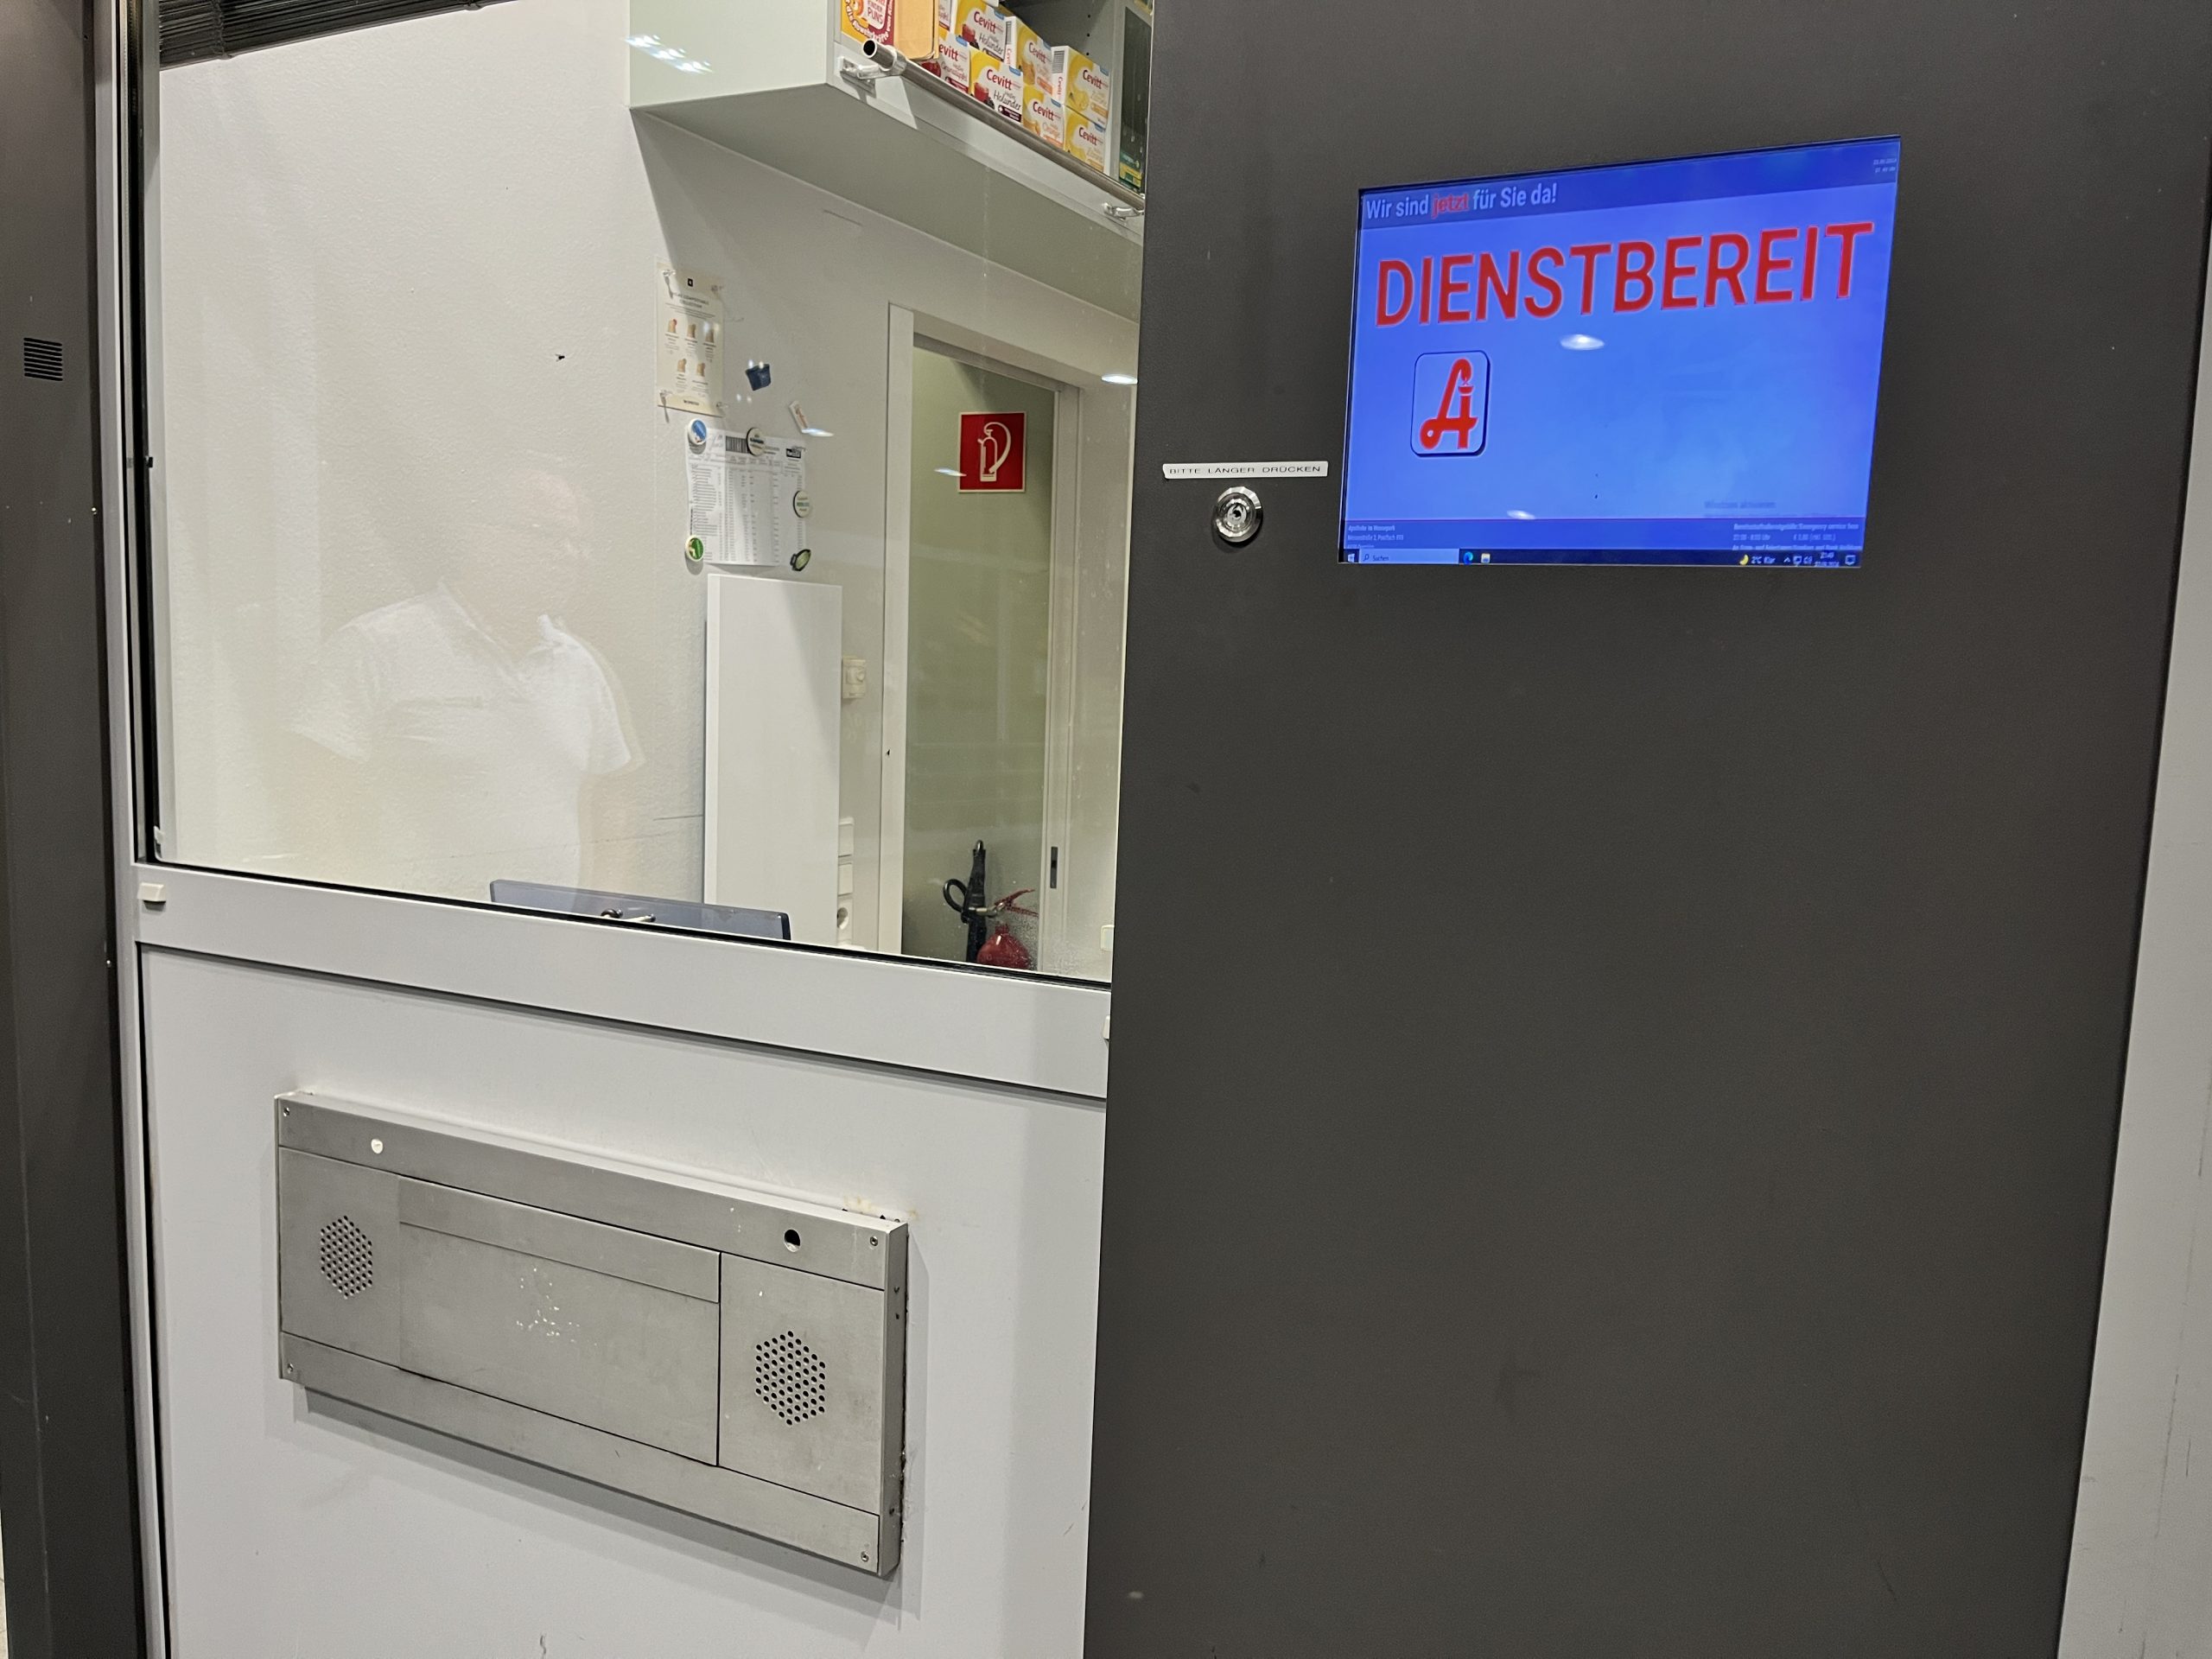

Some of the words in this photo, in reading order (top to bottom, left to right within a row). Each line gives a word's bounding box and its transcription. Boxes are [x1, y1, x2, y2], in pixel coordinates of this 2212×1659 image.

[974, 11, 996, 34] Cevitt
[939, 44, 959, 61] evitt
[1029, 42, 1046, 63] Cevitt
[987, 69, 1012, 90] Cevitt
[1083, 70, 1103, 89] Cevitt
[994, 90, 1021, 111] Holunder
[1033, 102, 1054, 121] Cevitt
[1079, 127, 1097, 146] Cevitt
[1366, 200, 1391, 219] Wir
[1395, 194, 1429, 218] sind
[1431, 193, 1470, 220] jetzt
[1472, 188, 1496, 211] für
[1500, 186, 1526, 208] Sie
[1530, 182, 1558, 205] da!
[1375, 222, 1874, 327] DIENSTBEREIT
[1262, 465, 1321, 474] DRÜCKEN
